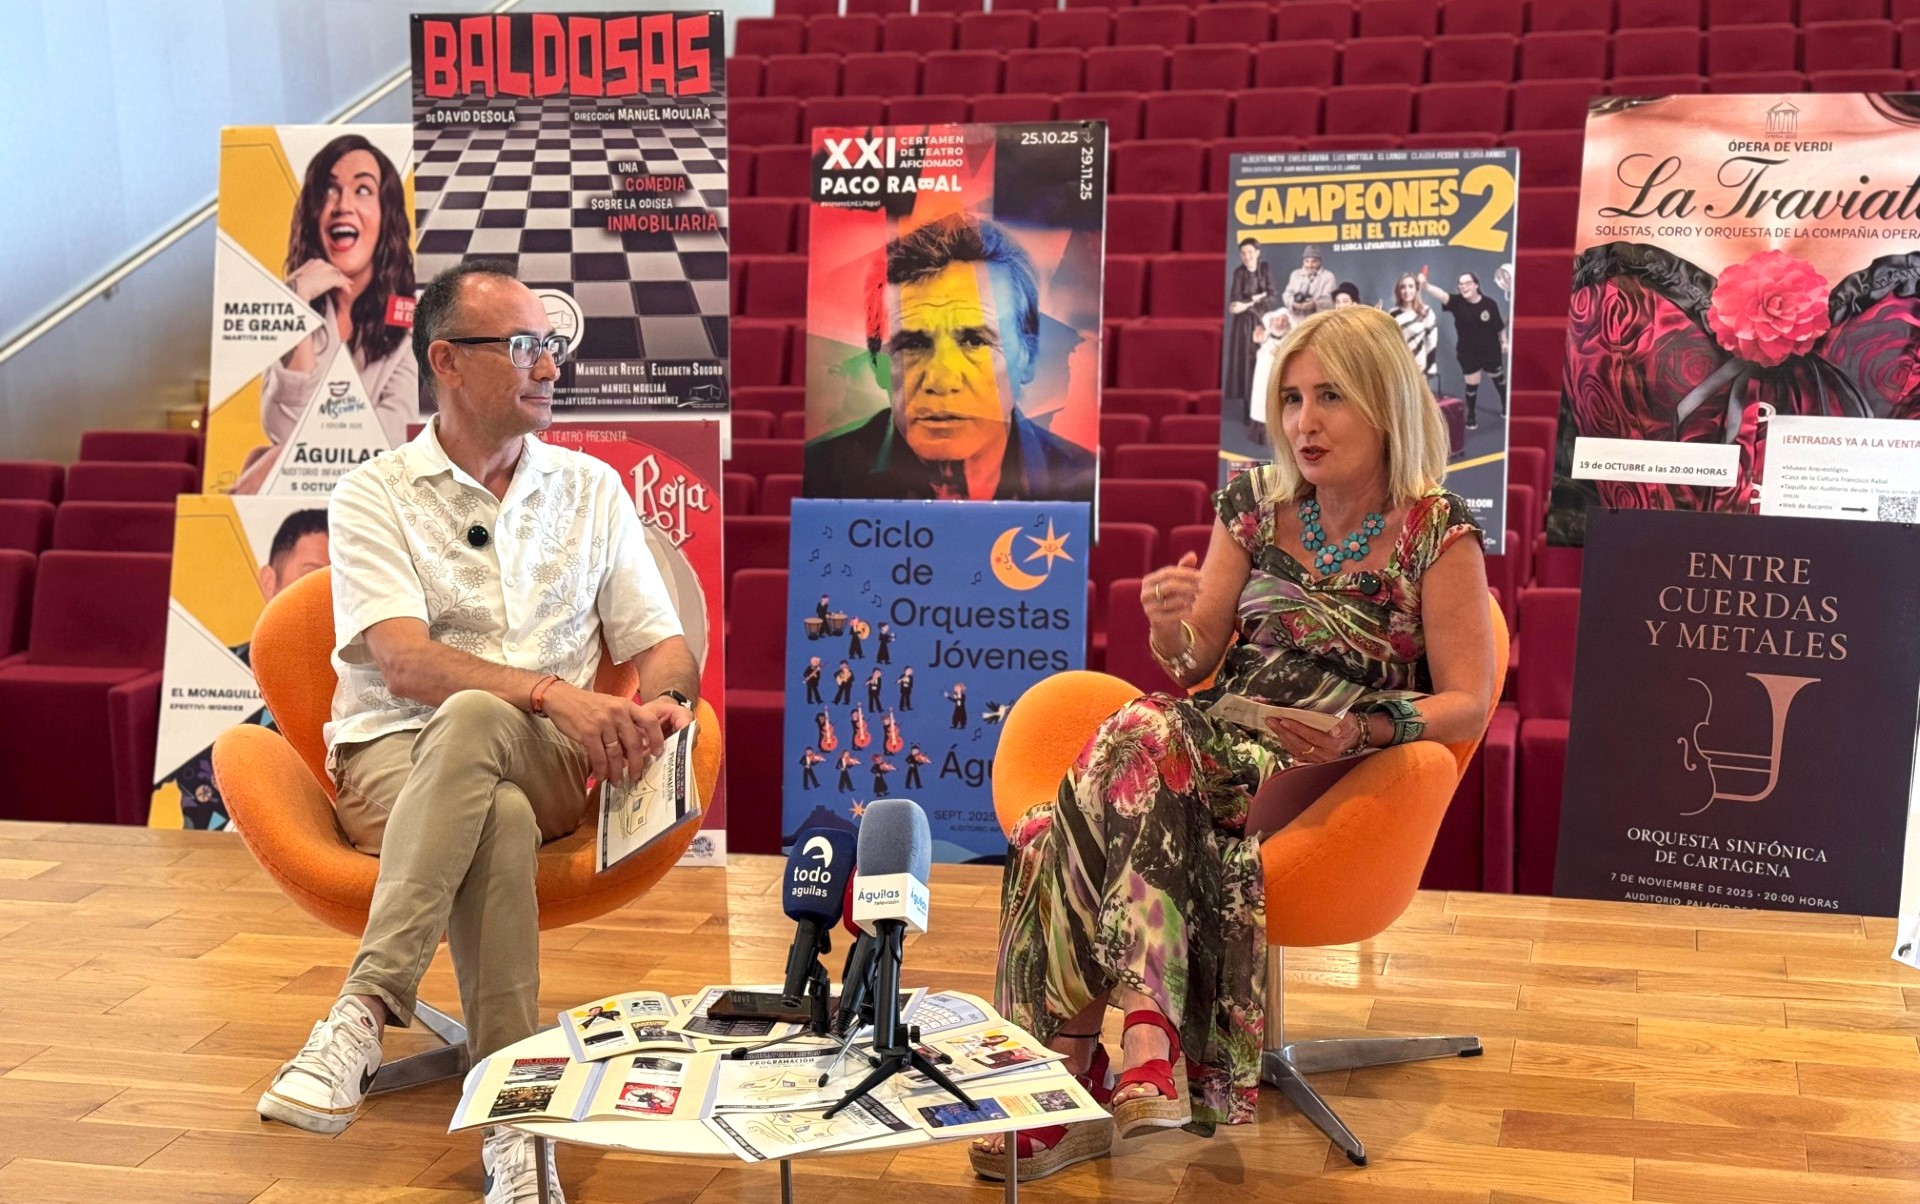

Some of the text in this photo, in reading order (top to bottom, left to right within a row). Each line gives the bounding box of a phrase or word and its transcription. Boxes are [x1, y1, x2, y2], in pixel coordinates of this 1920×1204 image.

[423, 13, 711, 98] BALDOSAS
[426, 110, 516, 124] DE DAVID DESOLA
[618, 108, 661, 122] MANUEL
[900, 135, 964, 146] CERTAMEN
[1020, 131, 1078, 145] 25.10.25
[1728, 139, 1832, 152] ÓPERA DE VERDI
[822, 136, 896, 170] XXI
[900, 146, 963, 157] DE TEATRO
[618, 162, 638, 174] UNA
[900, 158, 963, 168] AFICIONADO
[1080, 147, 1093, 201] 29.11.25
[625, 176, 686, 193] COMEDIA
[820, 176, 880, 195] PACO
[1597, 153, 1920, 221] La Traviat
[591, 198, 673, 210] SOBRE LA ODISEA
[1234, 164, 1515, 252] CAMPEONES 2
[607, 213, 718, 233] INMOBILIARIA
[1341, 220, 1450, 240] EN EL TEATRO
[1595, 226, 1655, 238] SOLISTAS,
[1658, 226, 1692, 236] CORO
[1694, 227, 1704, 236] Y
[1704, 226, 1771, 239] ORQUESTA
[1775, 228, 1791, 238] DE
[1794, 228, 1810, 238] LA
[1403, 240, 1412, 248] LA
[224, 302, 295, 315] MARTITA
[223, 319, 245, 332] DE
[576, 362, 608, 376] MANUEL
[610, 366, 619, 376] DE
[620, 362, 645, 376] REYES
[652, 362, 691, 376] ELIZABETH
[601, 384, 632, 393] MANUEL
[552, 430, 583, 443] TEATRO
[586, 430, 627, 443] PRESENTA
[1845, 437, 1858, 447] YA
[1861, 438, 1868, 447] A
[1871, 438, 1884, 448] LA
[1580, 461, 1589, 469] 19
[1592, 461, 1603, 469] de
[1605, 462, 1646, 472] OCTUBRE
[1655, 465, 1667, 473] las
[1670, 466, 1694, 474] 20:00
[1696, 467, 1728, 476] HORAS
[291, 482, 298, 491] 5
[629, 454, 712, 549] Roja
[848, 518, 934, 549] Ciclo
[891, 557, 934, 586] de
[1687, 552, 1811, 585] ENTRE
[1658, 585, 1839, 624] CUERDAS
[890, 598, 1070, 636] Orquestas
[1644, 620, 1848, 661] Y METALES
[928, 639, 1069, 671] Jóvenes
[171, 688, 185, 697] EL
[968, 811, 997, 822] 2025
[1627, 827, 1828, 863] ORQUESTA SINFÓNICA
[1654, 850, 1792, 879] DE CARTAGENA
[793, 866, 832, 884] todo
[791, 885, 828, 898] aguilas
[857, 888, 900, 903] Águilas
[1610, 872, 1840, 910] 7 DE NOVIEMBRE DE 2025 20:00 HORAS
[749, 1057, 815, 1067] PROGRAMACIÓN
